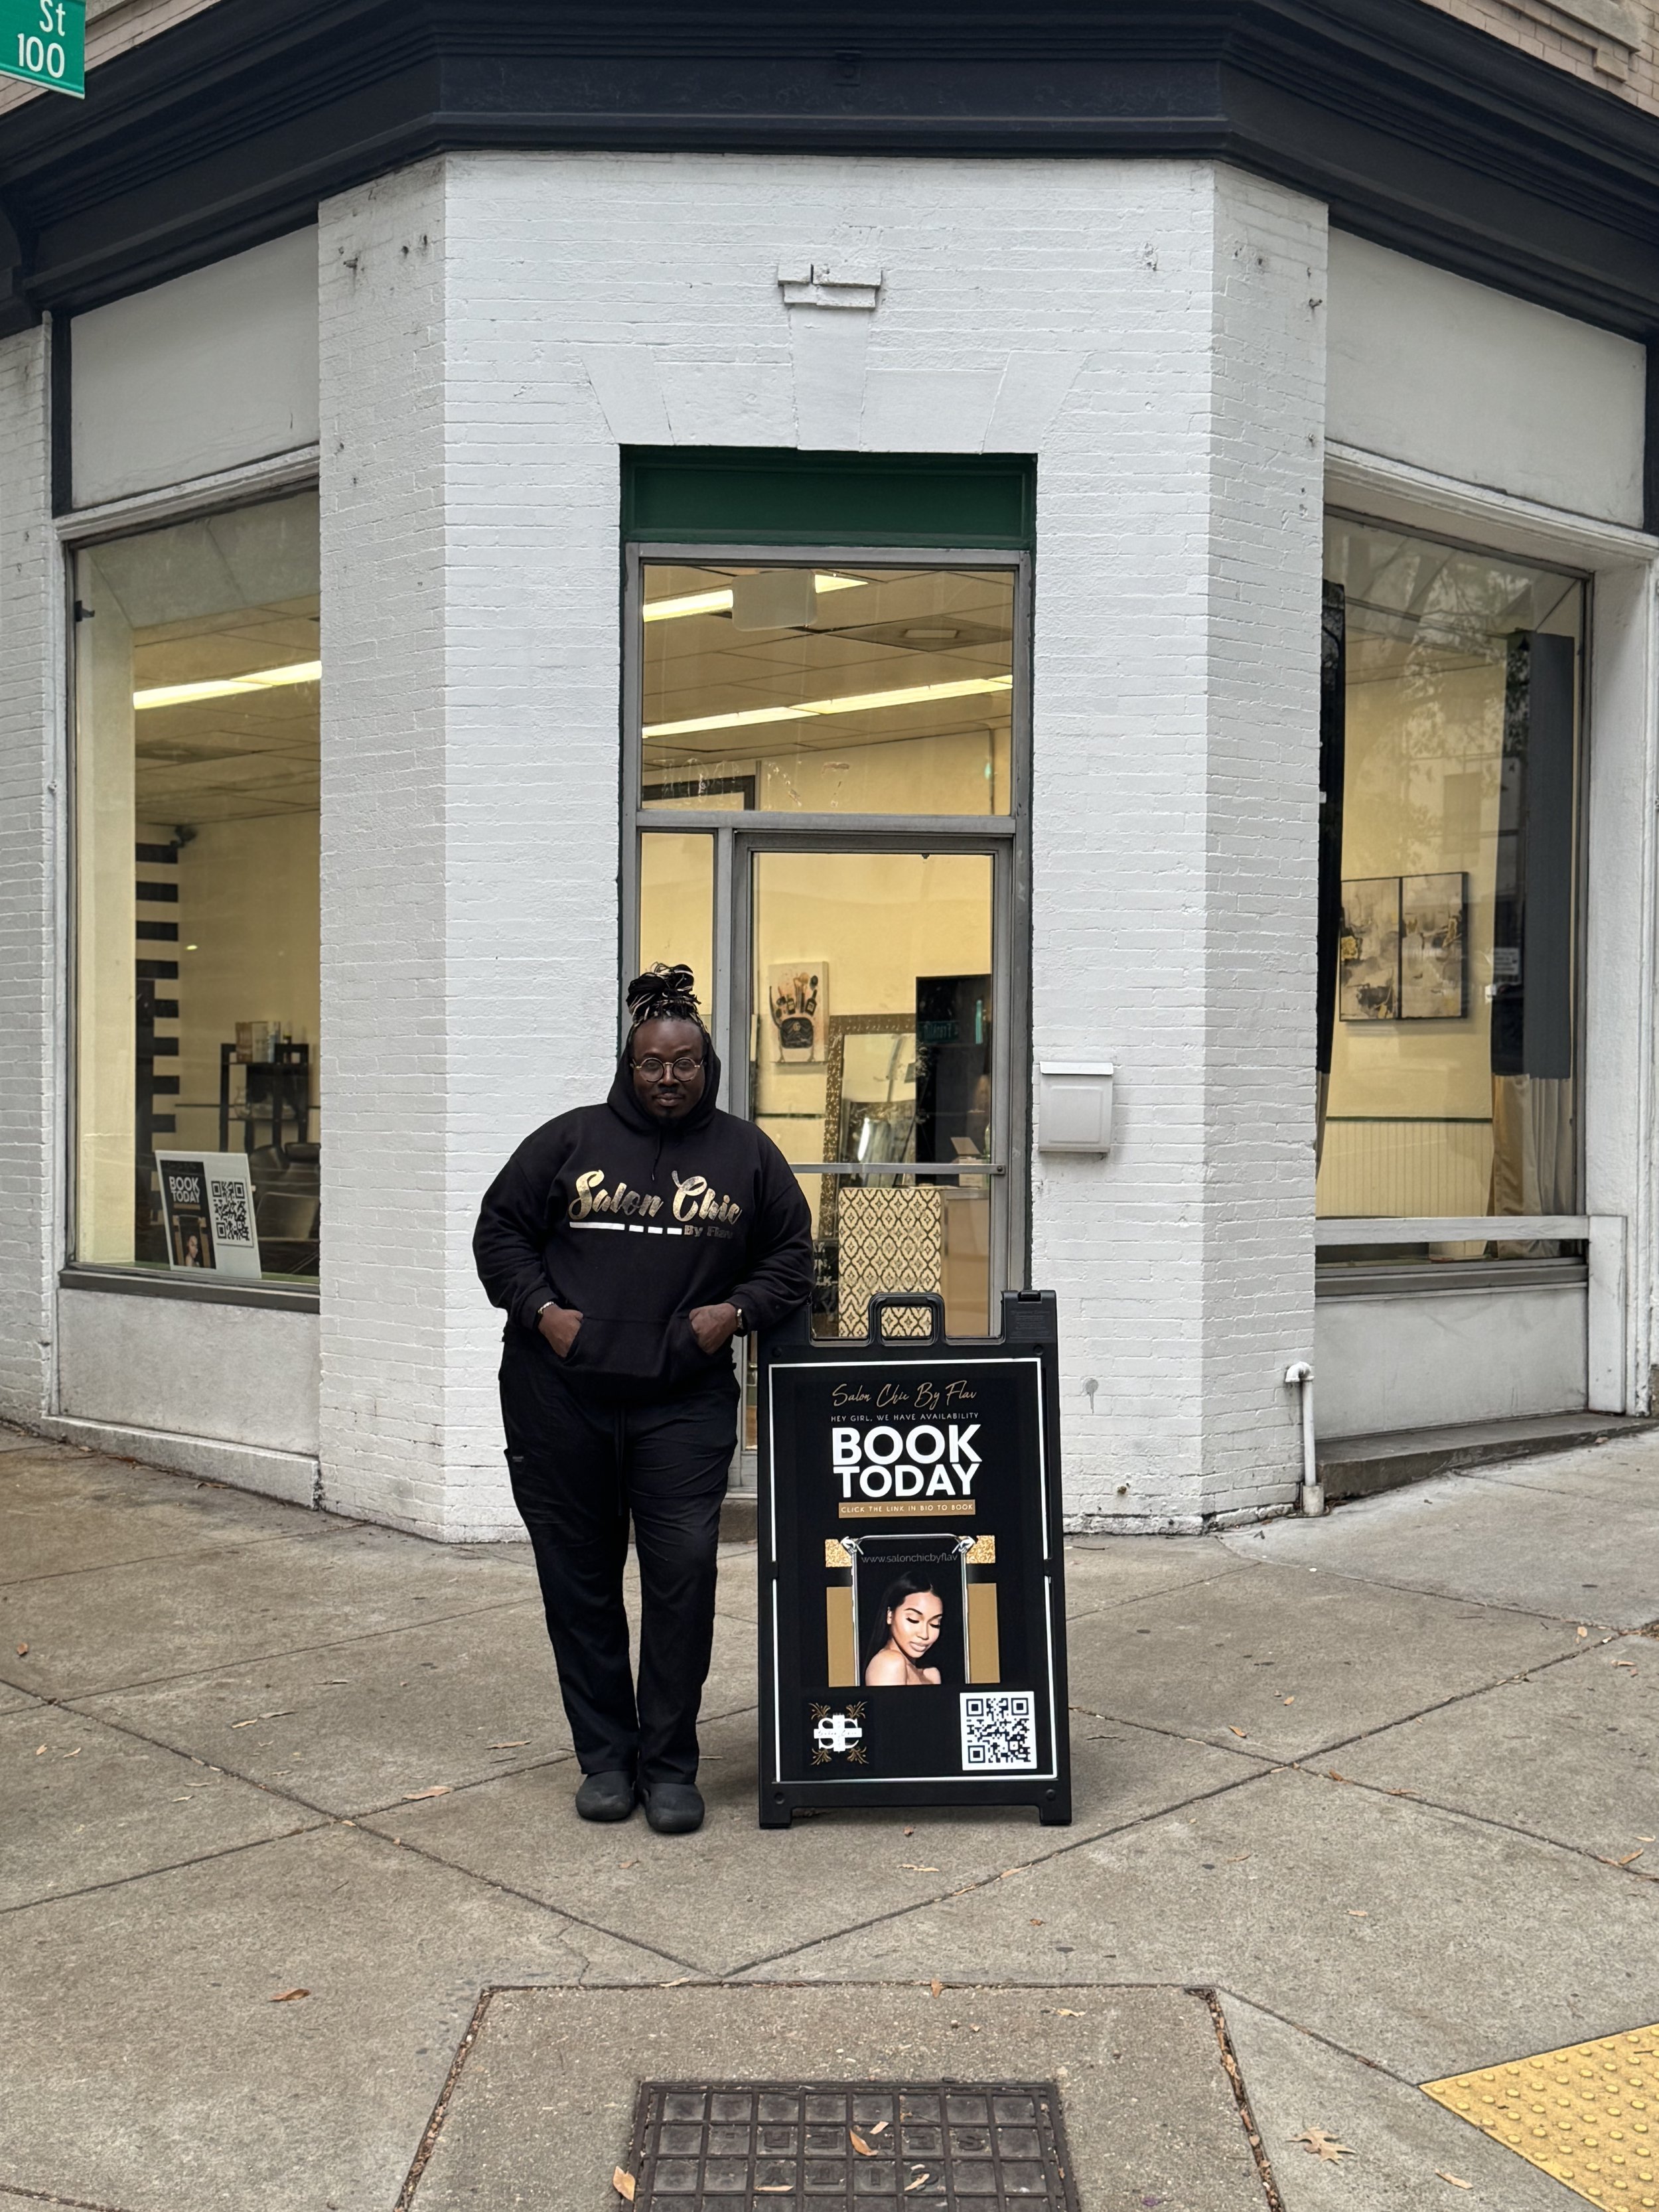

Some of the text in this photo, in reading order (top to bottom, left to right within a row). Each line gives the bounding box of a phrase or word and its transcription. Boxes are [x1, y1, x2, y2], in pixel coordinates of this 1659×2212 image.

[39, 0, 66, 37] St
[17, 33, 65, 78] 100
[169, 1175, 200, 1192] BOOK
[171, 1190, 200, 1203] TODAY
[568, 1169, 743, 1225] Salon Chic
[832, 1380, 977, 1410] Salon Chic By Flav
[832, 1424, 983, 1465] BOOK
[833, 1463, 981, 1498] TODAY
[861, 1552, 958, 1564] www.salonchicbyflav
